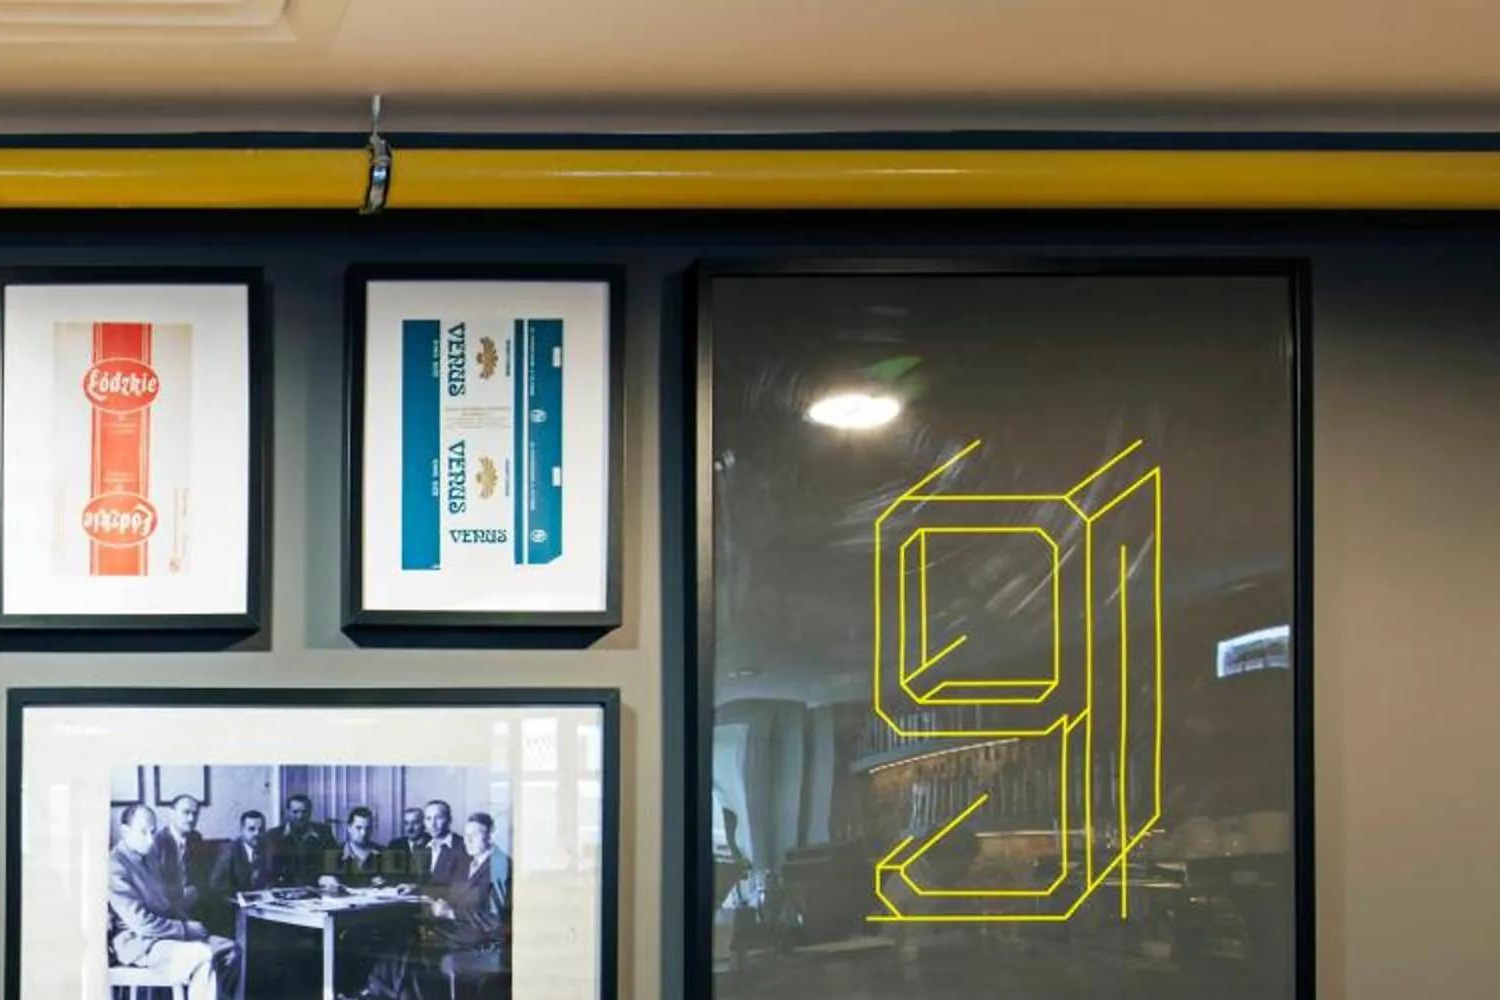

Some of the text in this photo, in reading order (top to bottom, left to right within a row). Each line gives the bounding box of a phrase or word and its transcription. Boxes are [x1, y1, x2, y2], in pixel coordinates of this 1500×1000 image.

[448, 322, 466, 397] VERUS
[448, 440, 466, 514] VERUS
[449, 529, 507, 544] VERUS
